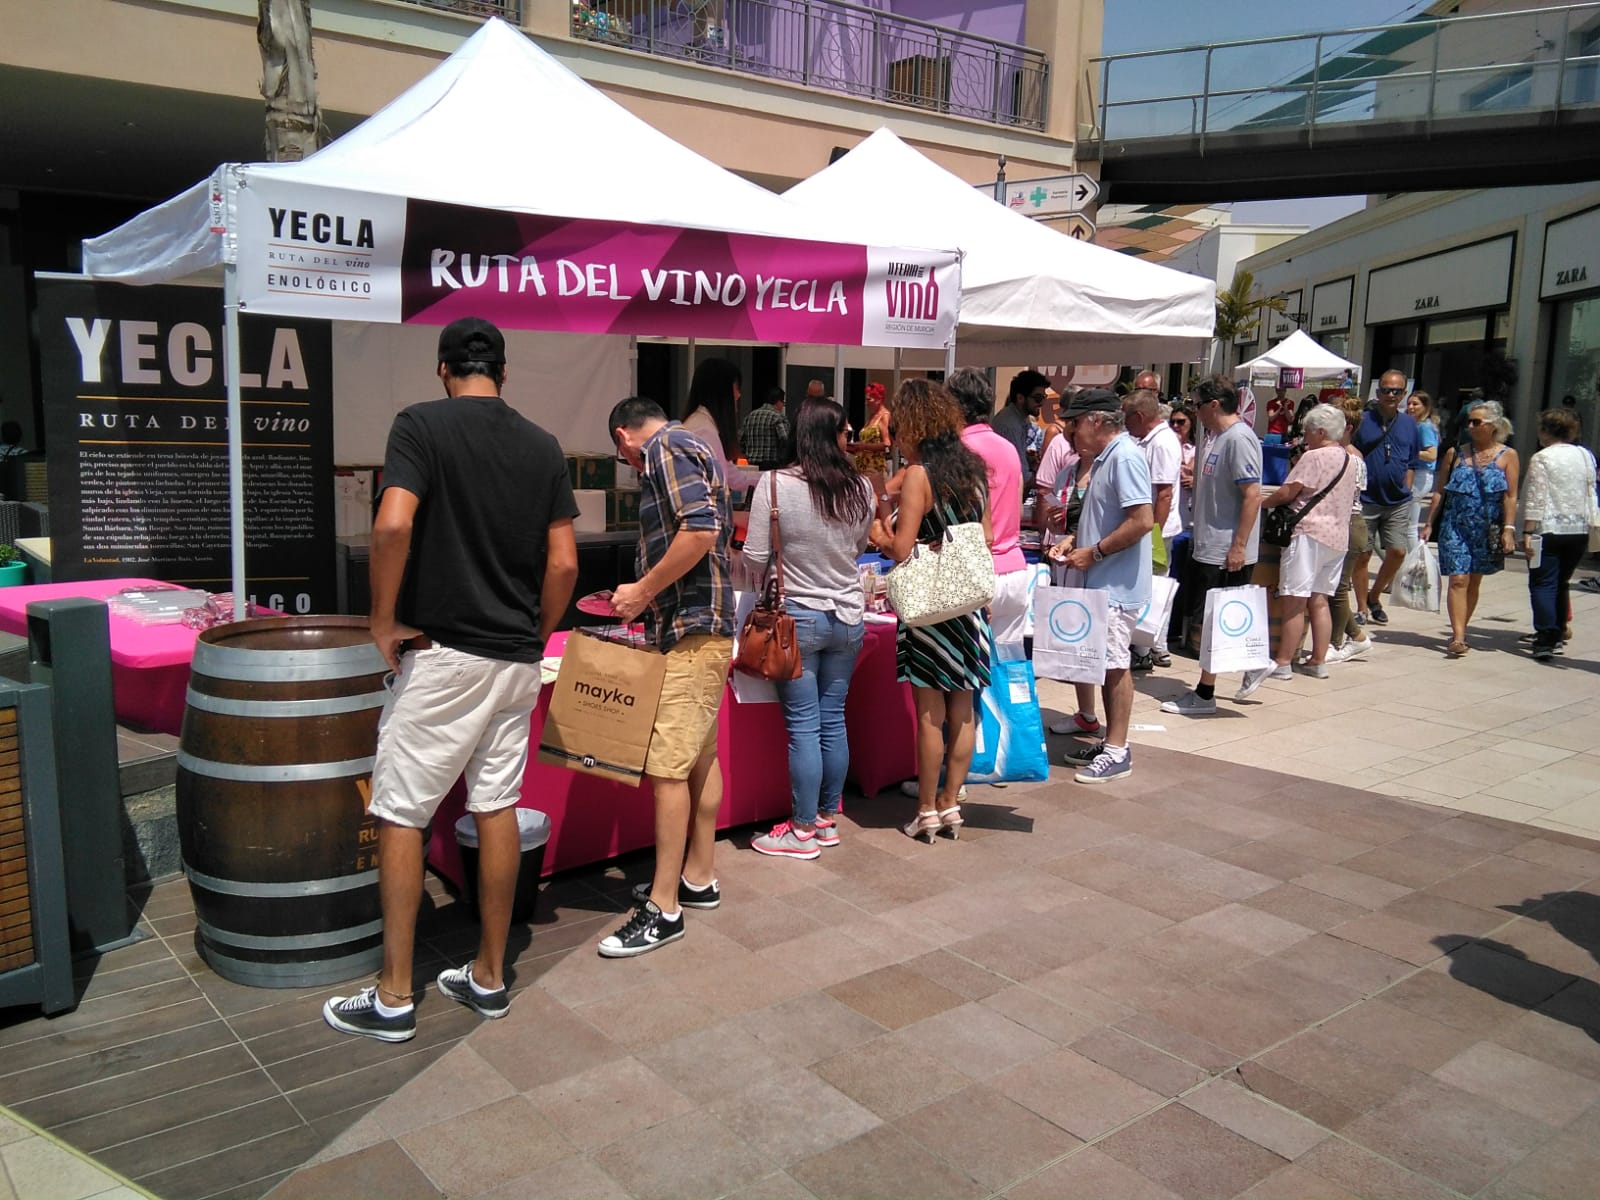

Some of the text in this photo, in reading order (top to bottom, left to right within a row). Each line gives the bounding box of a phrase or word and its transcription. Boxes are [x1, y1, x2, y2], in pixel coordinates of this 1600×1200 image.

[268, 207, 374, 248] YECLA
[268, 251, 371, 269] RUTA DEL vino
[894, 262, 918, 277] FERIA
[268, 272, 371, 294] ENOLÓGICO
[430, 247, 849, 317] RUTA DEL VINO YECLA
[1556, 266, 1587, 286] ZARA
[1414, 296, 1440, 310] ZARA
[1320, 316, 1338, 326] ZARA
[80, 413, 160, 428] RUTA
[254, 411, 310, 432] vino
[574, 681, 635, 706] mayka
[582, 700, 620, 715] SHOES SHOP
[584, 756, 594, 766] m
